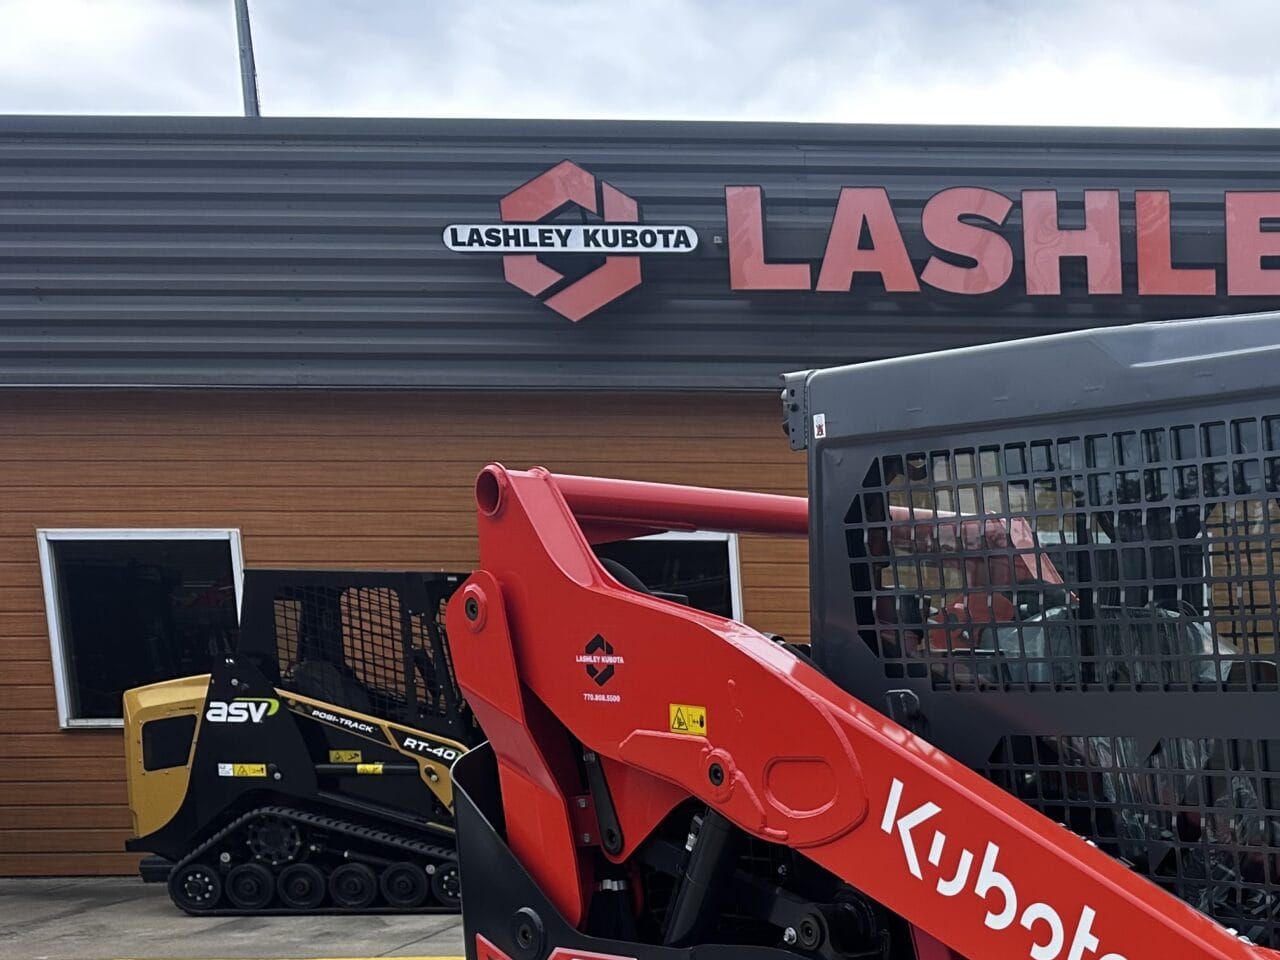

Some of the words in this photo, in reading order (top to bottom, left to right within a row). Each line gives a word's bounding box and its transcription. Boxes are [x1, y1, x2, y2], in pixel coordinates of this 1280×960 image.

[450, 227, 571, 248] LASHLEY
[583, 229, 692, 248] KUBOTA
[311, 709, 374, 733] POSI-TRACK
[402, 737, 456, 761] RT-40
